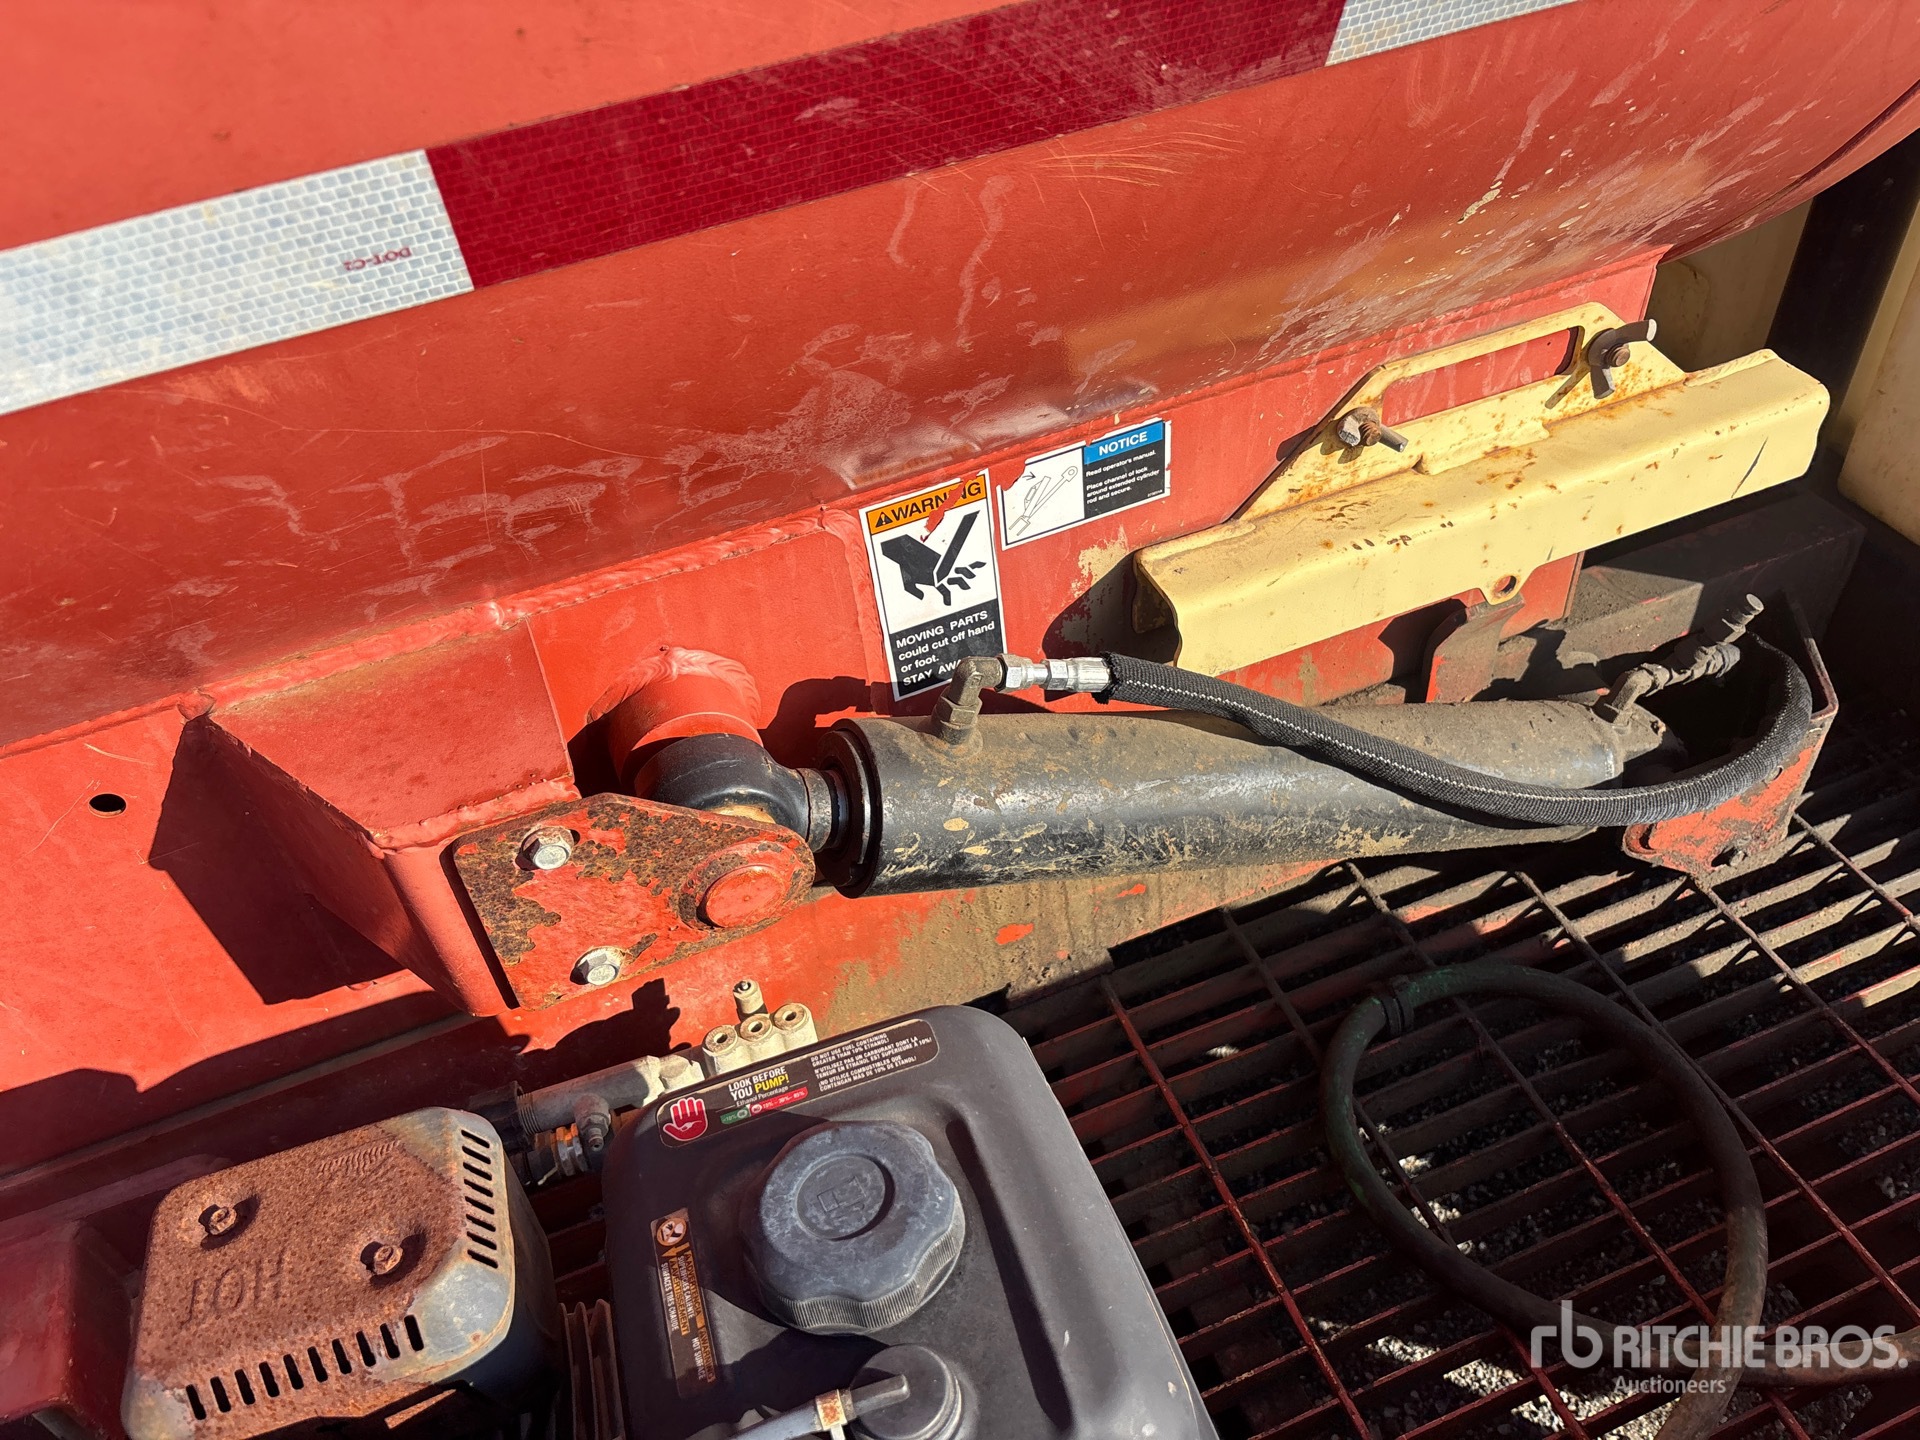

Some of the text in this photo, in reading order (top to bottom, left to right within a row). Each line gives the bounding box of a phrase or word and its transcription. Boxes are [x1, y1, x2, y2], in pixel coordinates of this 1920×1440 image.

[344, 246, 412, 271] DOT-C2
[1098, 430, 1147, 456] NOTICE
[1085, 449, 1156, 477] Read operator's manual.
[1086, 480, 1102, 490] Place
[1103, 472, 1127, 484] channel
[1135, 466, 1147, 474] lock
[1086, 468, 1159, 497] around extended cylinder
[891, 481, 981, 521] WARNNG
[1086, 485, 1131, 504] rod and secure.
[896, 609, 988, 648] MOVING PARTS
[898, 620, 995, 661] could cut off hand
[900, 652, 939, 673] or foot.
[902, 669, 933, 686] STAY
[812, 1055, 836, 1067] GREATER
[836, 1050, 851, 1058] THAN
[863, 1037, 889, 1050] ETHANOL!
[819, 1051, 830, 1059] NOT
[842, 1043, 854, 1051] FUEL
[855, 1033, 887, 1047] CONTAINING
[863, 1043, 894, 1057] CARBURANT
[895, 1038, 909, 1047] DONT
[727, 1065, 786, 1091] LOOK BEFORE
[816, 1068, 836, 1079] TENEUR
[819, 1077, 852, 1091] CONTENGAN
[828, 1072, 849, 1083] UTILICE
[850, 1059, 890, 1076] COMBUSTIBLES
[730, 1073, 790, 1101] YOU PUMP!
[735, 1085, 788, 1107] Ethanol Percentage
[660, 1262, 672, 1291] SURFACES
[668, 1306, 678, 1331] CHAUDE
[671, 1265, 688, 1332] AVERTISSEMENT
[686, 1259, 702, 1316] ADVERTENCIA
[684, 1291, 694, 1318] CALIENTE
[691, 1337, 705, 1379] HOT SURFACE
[700, 1335, 714, 1379] WARNING
